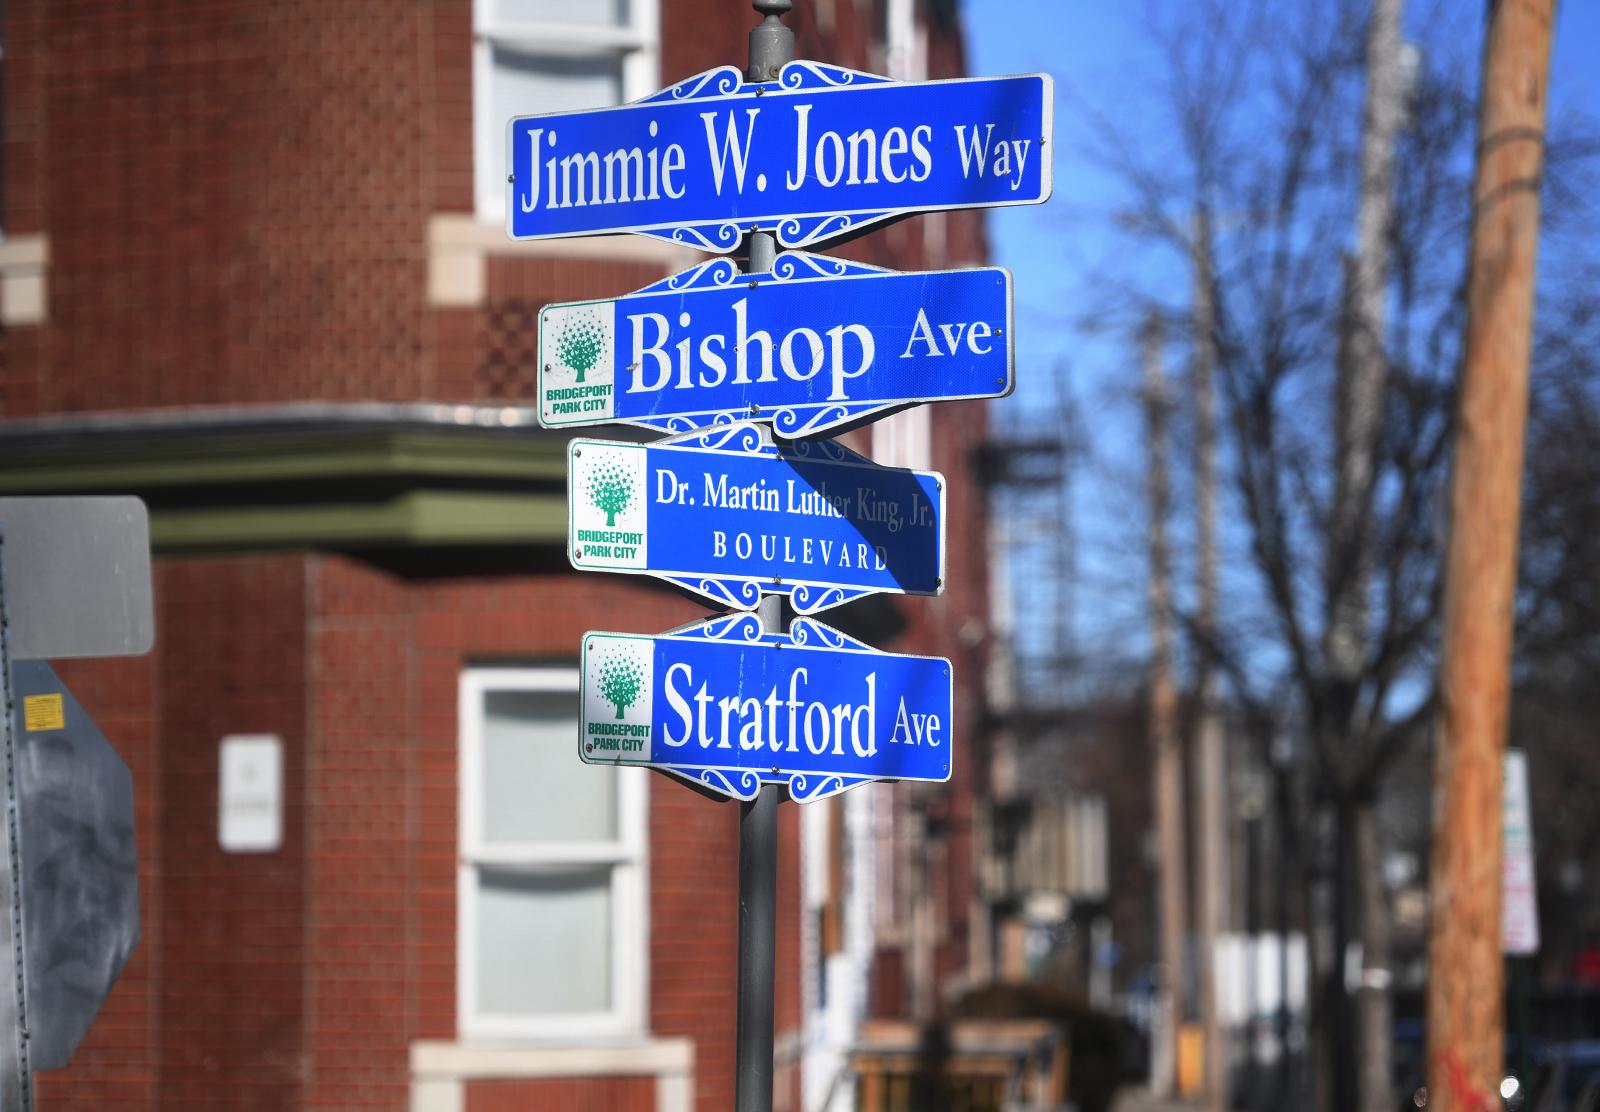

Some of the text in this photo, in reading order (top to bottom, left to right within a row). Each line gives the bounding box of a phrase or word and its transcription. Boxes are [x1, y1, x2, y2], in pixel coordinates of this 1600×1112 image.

[521, 104, 1031, 213] Jimmie W. Jones Way
[626, 297, 992, 400] Bishop Ave
[547, 384, 612, 400] BRIDGEPORT
[552, 399, 606, 414] PARK CITY
[655, 469, 934, 532] Dr. Martin Luther King, Jr.
[577, 529, 643, 546] BRIDGEPORT
[583, 545, 638, 559] PARK CITY
[713, 530, 889, 571] BOULEVARD
[663, 662, 941, 758] Stratford Ave
[588, 722, 651, 738] BRIDGEPORT
[593, 737, 645, 752] PARK CITY
